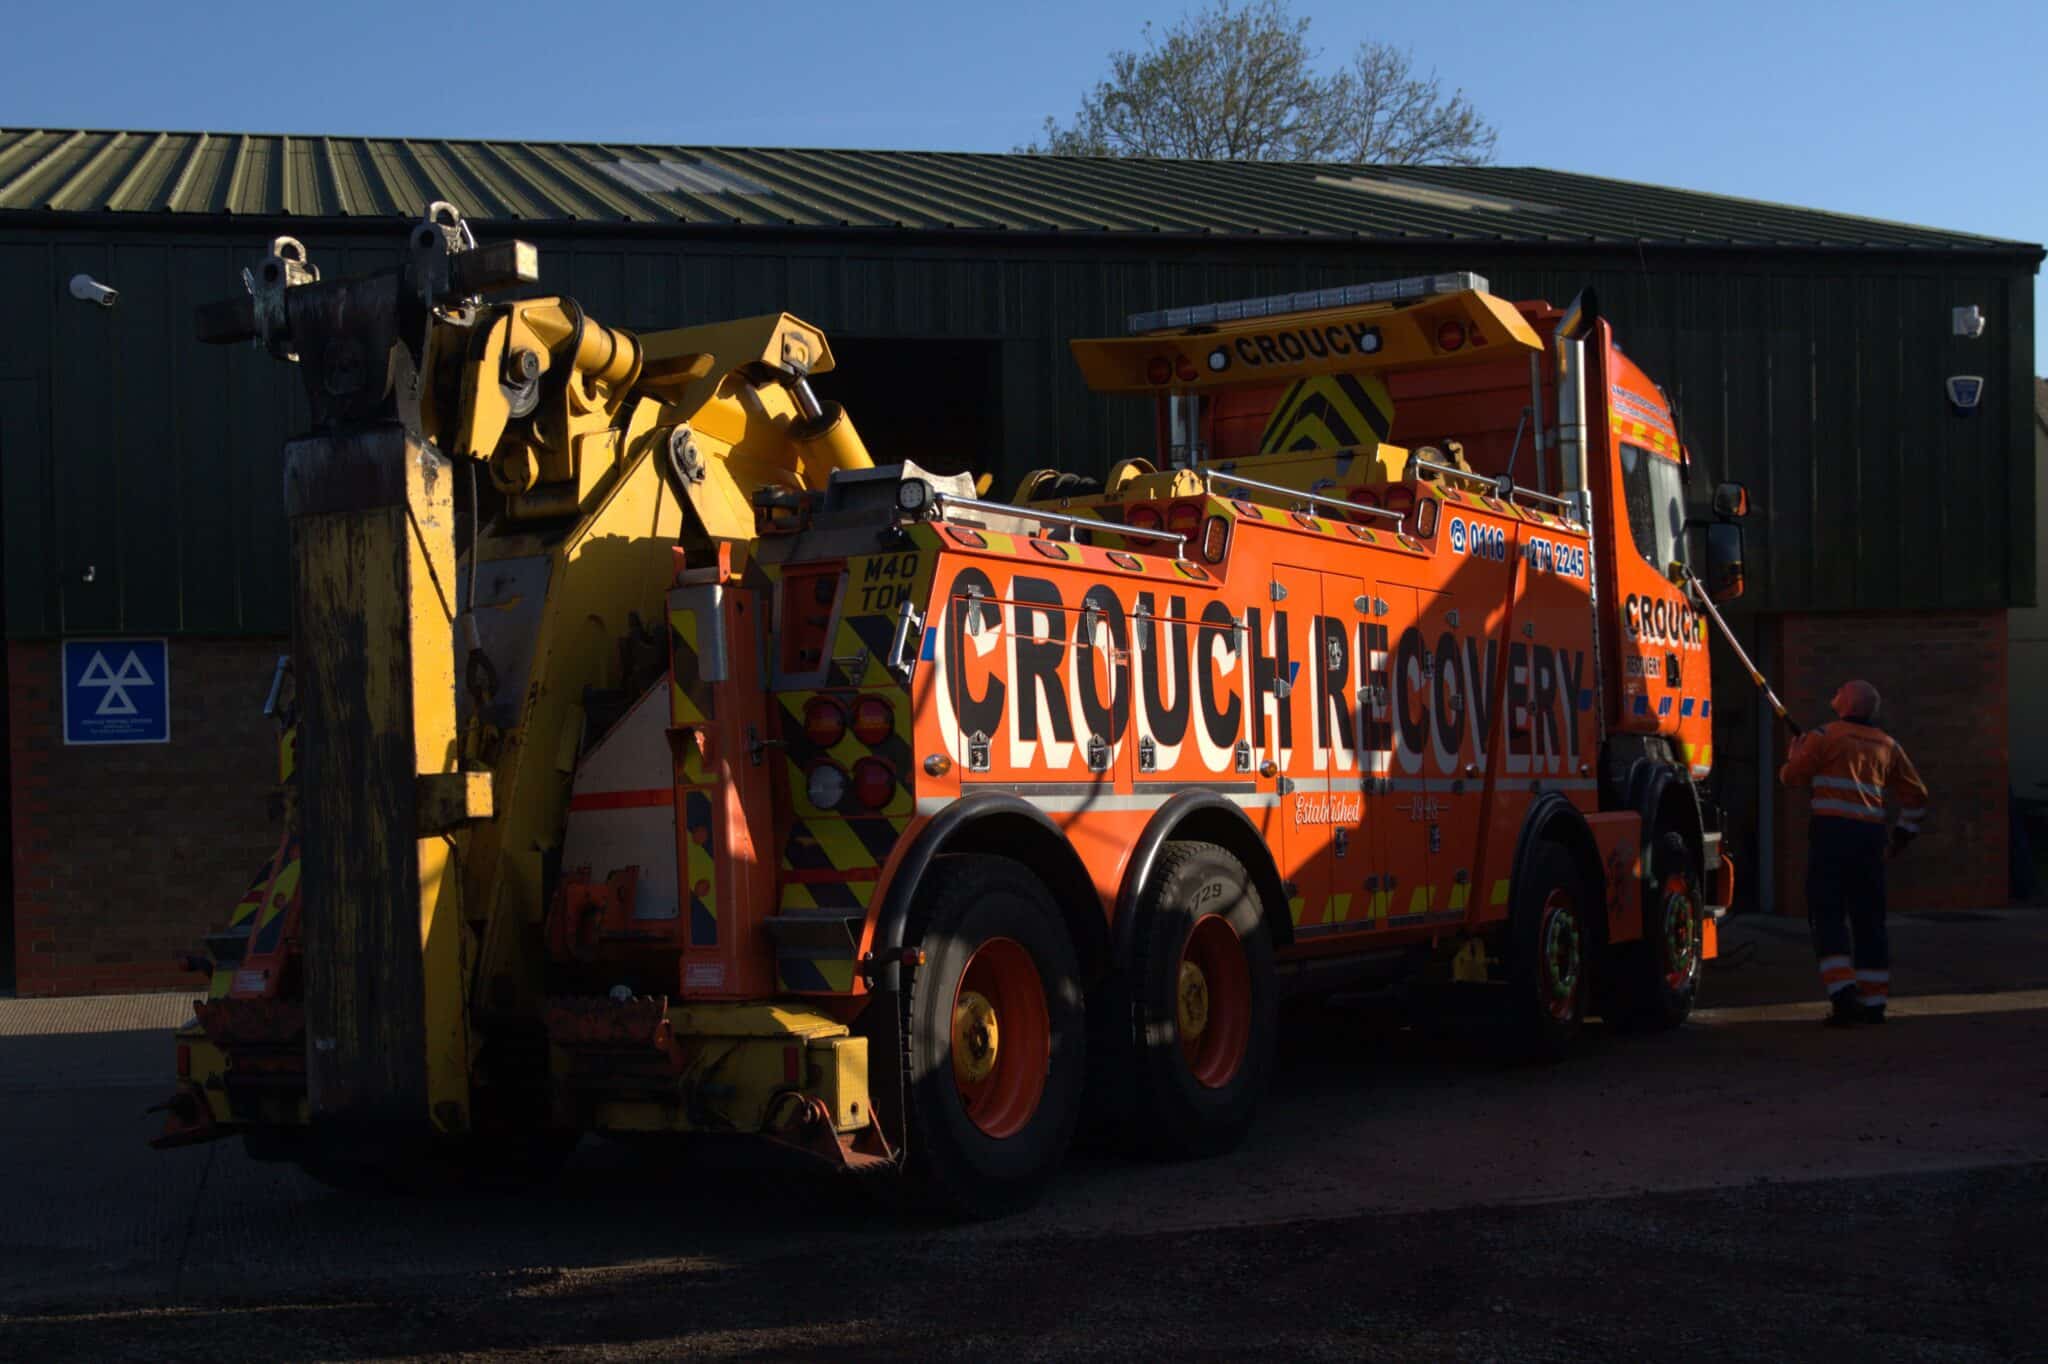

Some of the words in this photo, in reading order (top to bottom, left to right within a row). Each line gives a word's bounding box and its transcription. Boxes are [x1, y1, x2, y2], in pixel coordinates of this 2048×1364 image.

[863, 554, 918, 582] M40
[1470, 522, 1505, 562] 0116
[1529, 536, 1552, 573] 279
[1555, 542, 1584, 578] 2245
[862, 583, 912, 611] TOW
[1624, 593, 1701, 651] CROUCH
[935, 567, 1294, 773] CROUCH
[1308, 614, 1585, 775] RECOVERY
[1295, 793, 1361, 832] Established
